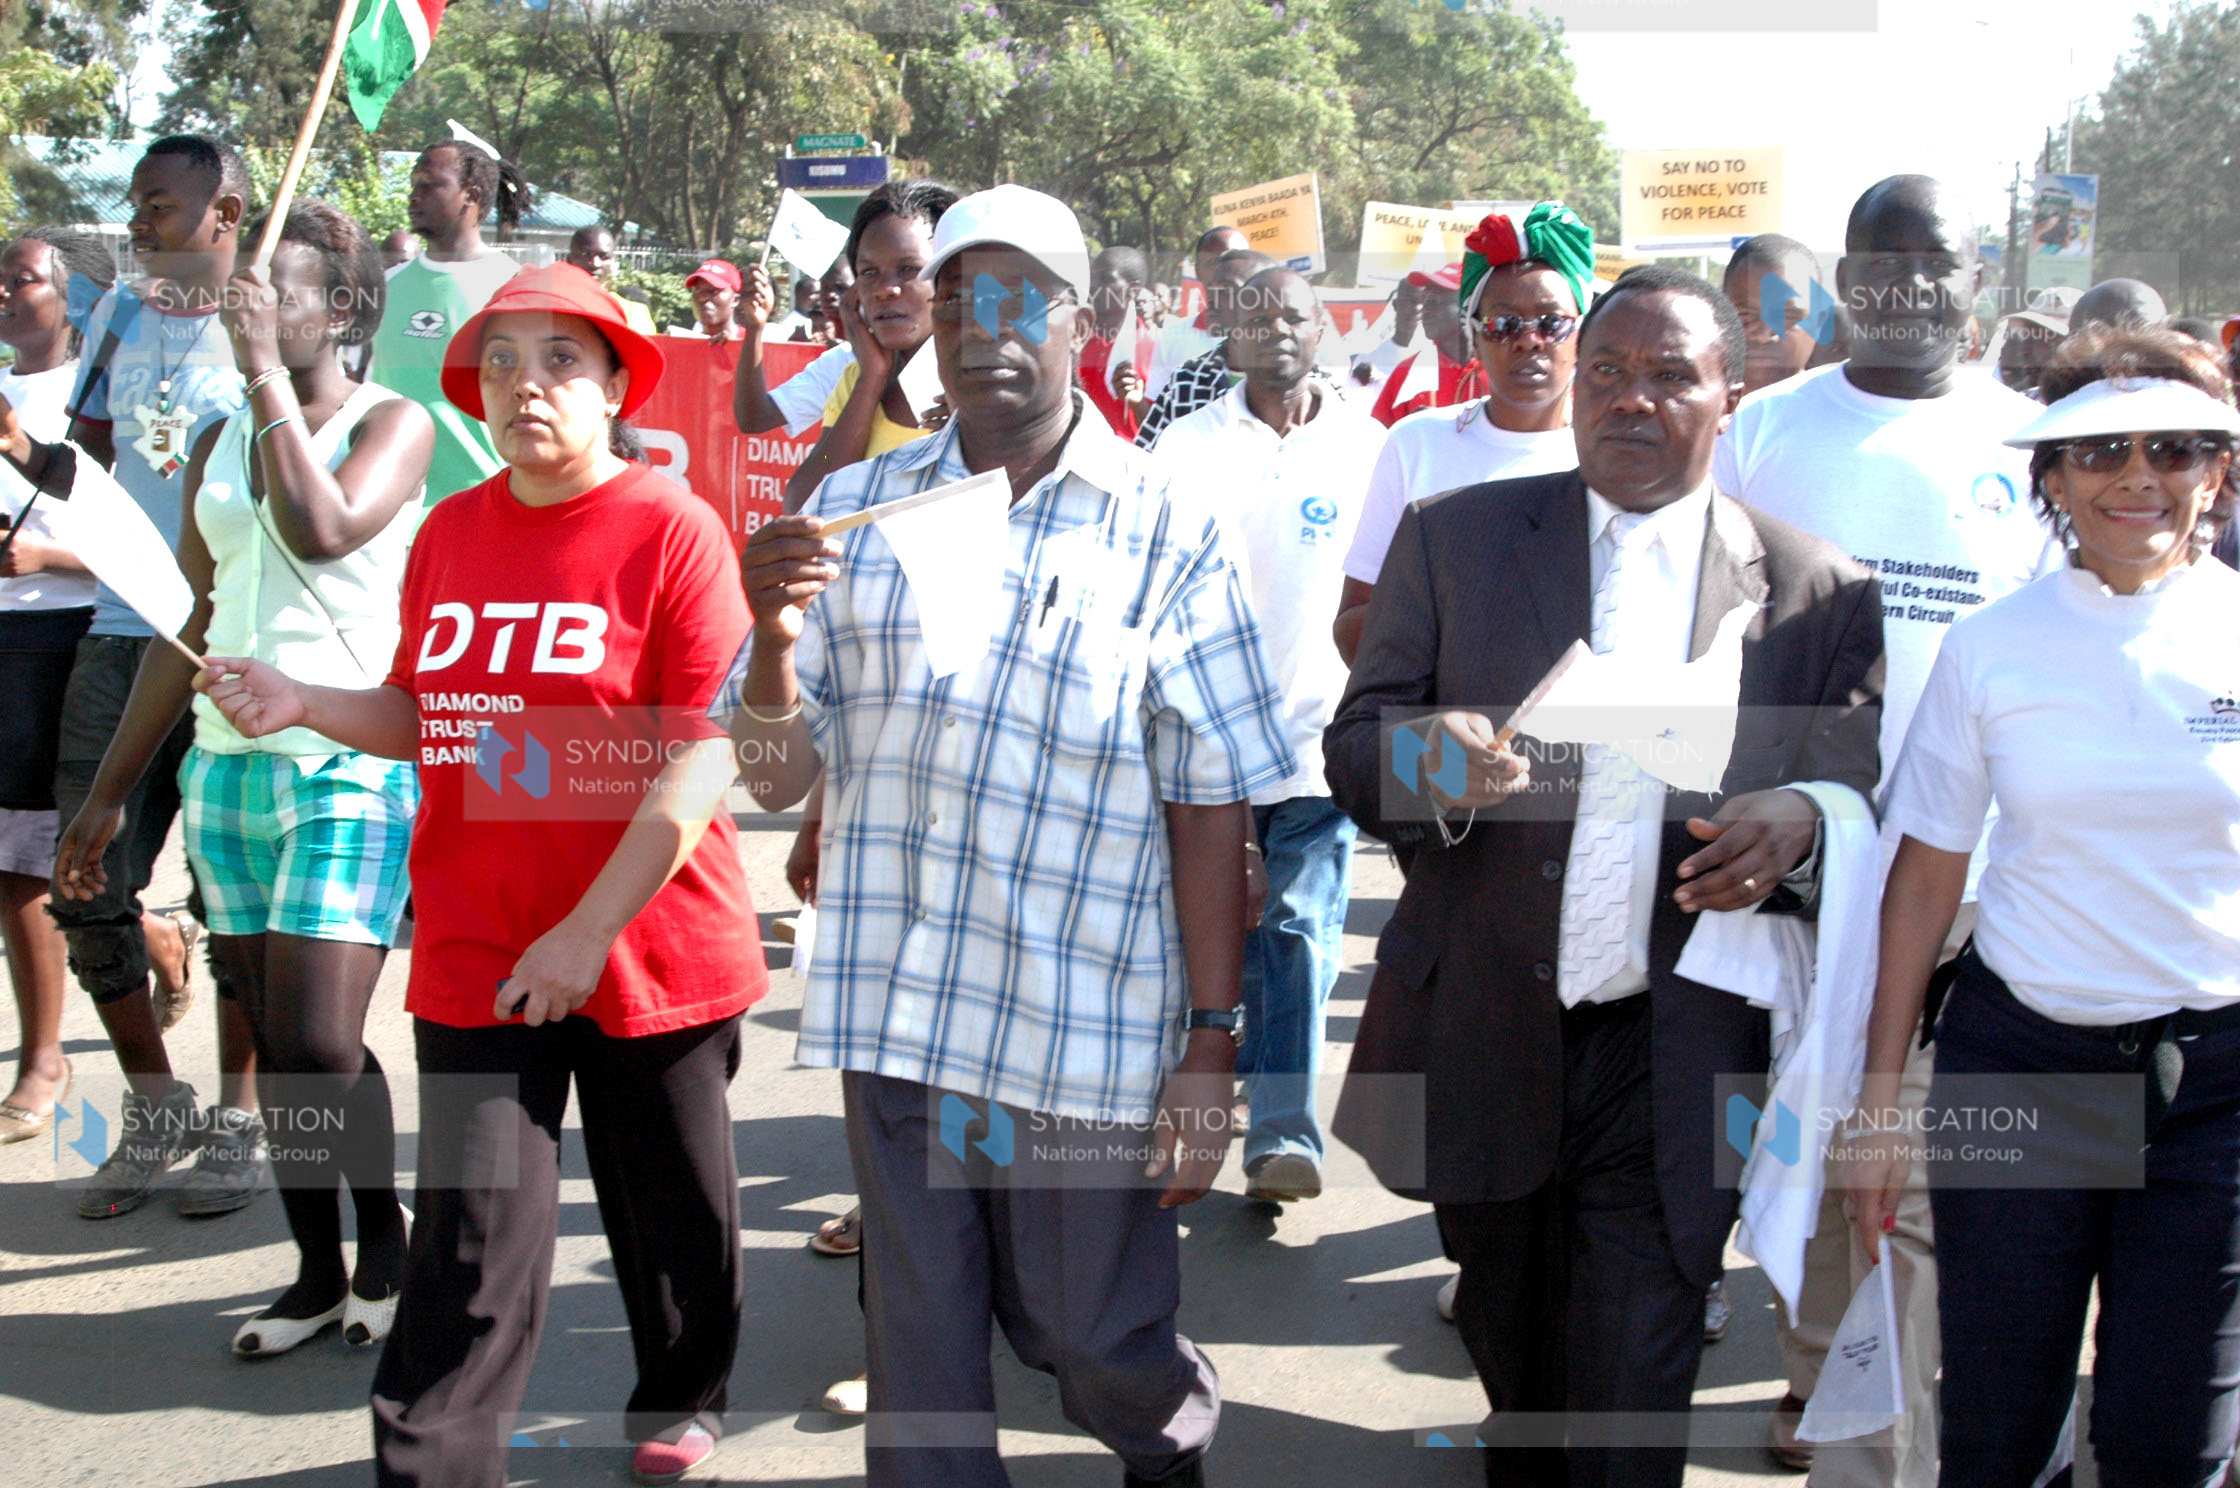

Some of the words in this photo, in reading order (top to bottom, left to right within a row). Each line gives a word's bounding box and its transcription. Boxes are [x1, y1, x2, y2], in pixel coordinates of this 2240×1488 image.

[1662, 162, 1690, 176] SAY
[1695, 160, 1719, 174] NO
[1724, 159, 1746, 173] TO
[1641, 182, 1722, 199] VIOLENCE,
[1728, 180, 1768, 195] VOTE
[1214, 202, 1238, 216] KUNA
[1240, 195, 1267, 209] KENYA
[1268, 188, 1298, 203] BAADA
[1300, 184, 1313, 196] YA
[1237, 213, 1269, 227] MARCH
[1375, 213, 1414, 229] PEACE,
[1418, 218, 1448, 232] LOE
[1662, 207, 1693, 221] FOR
[1698, 205, 1747, 220] PEACE
[149, 419, 182, 429] PEACE
[1881, 558, 1979, 584] Stakeholders
[415, 601, 610, 675] DTB
[421, 745, 486, 766] BANK
